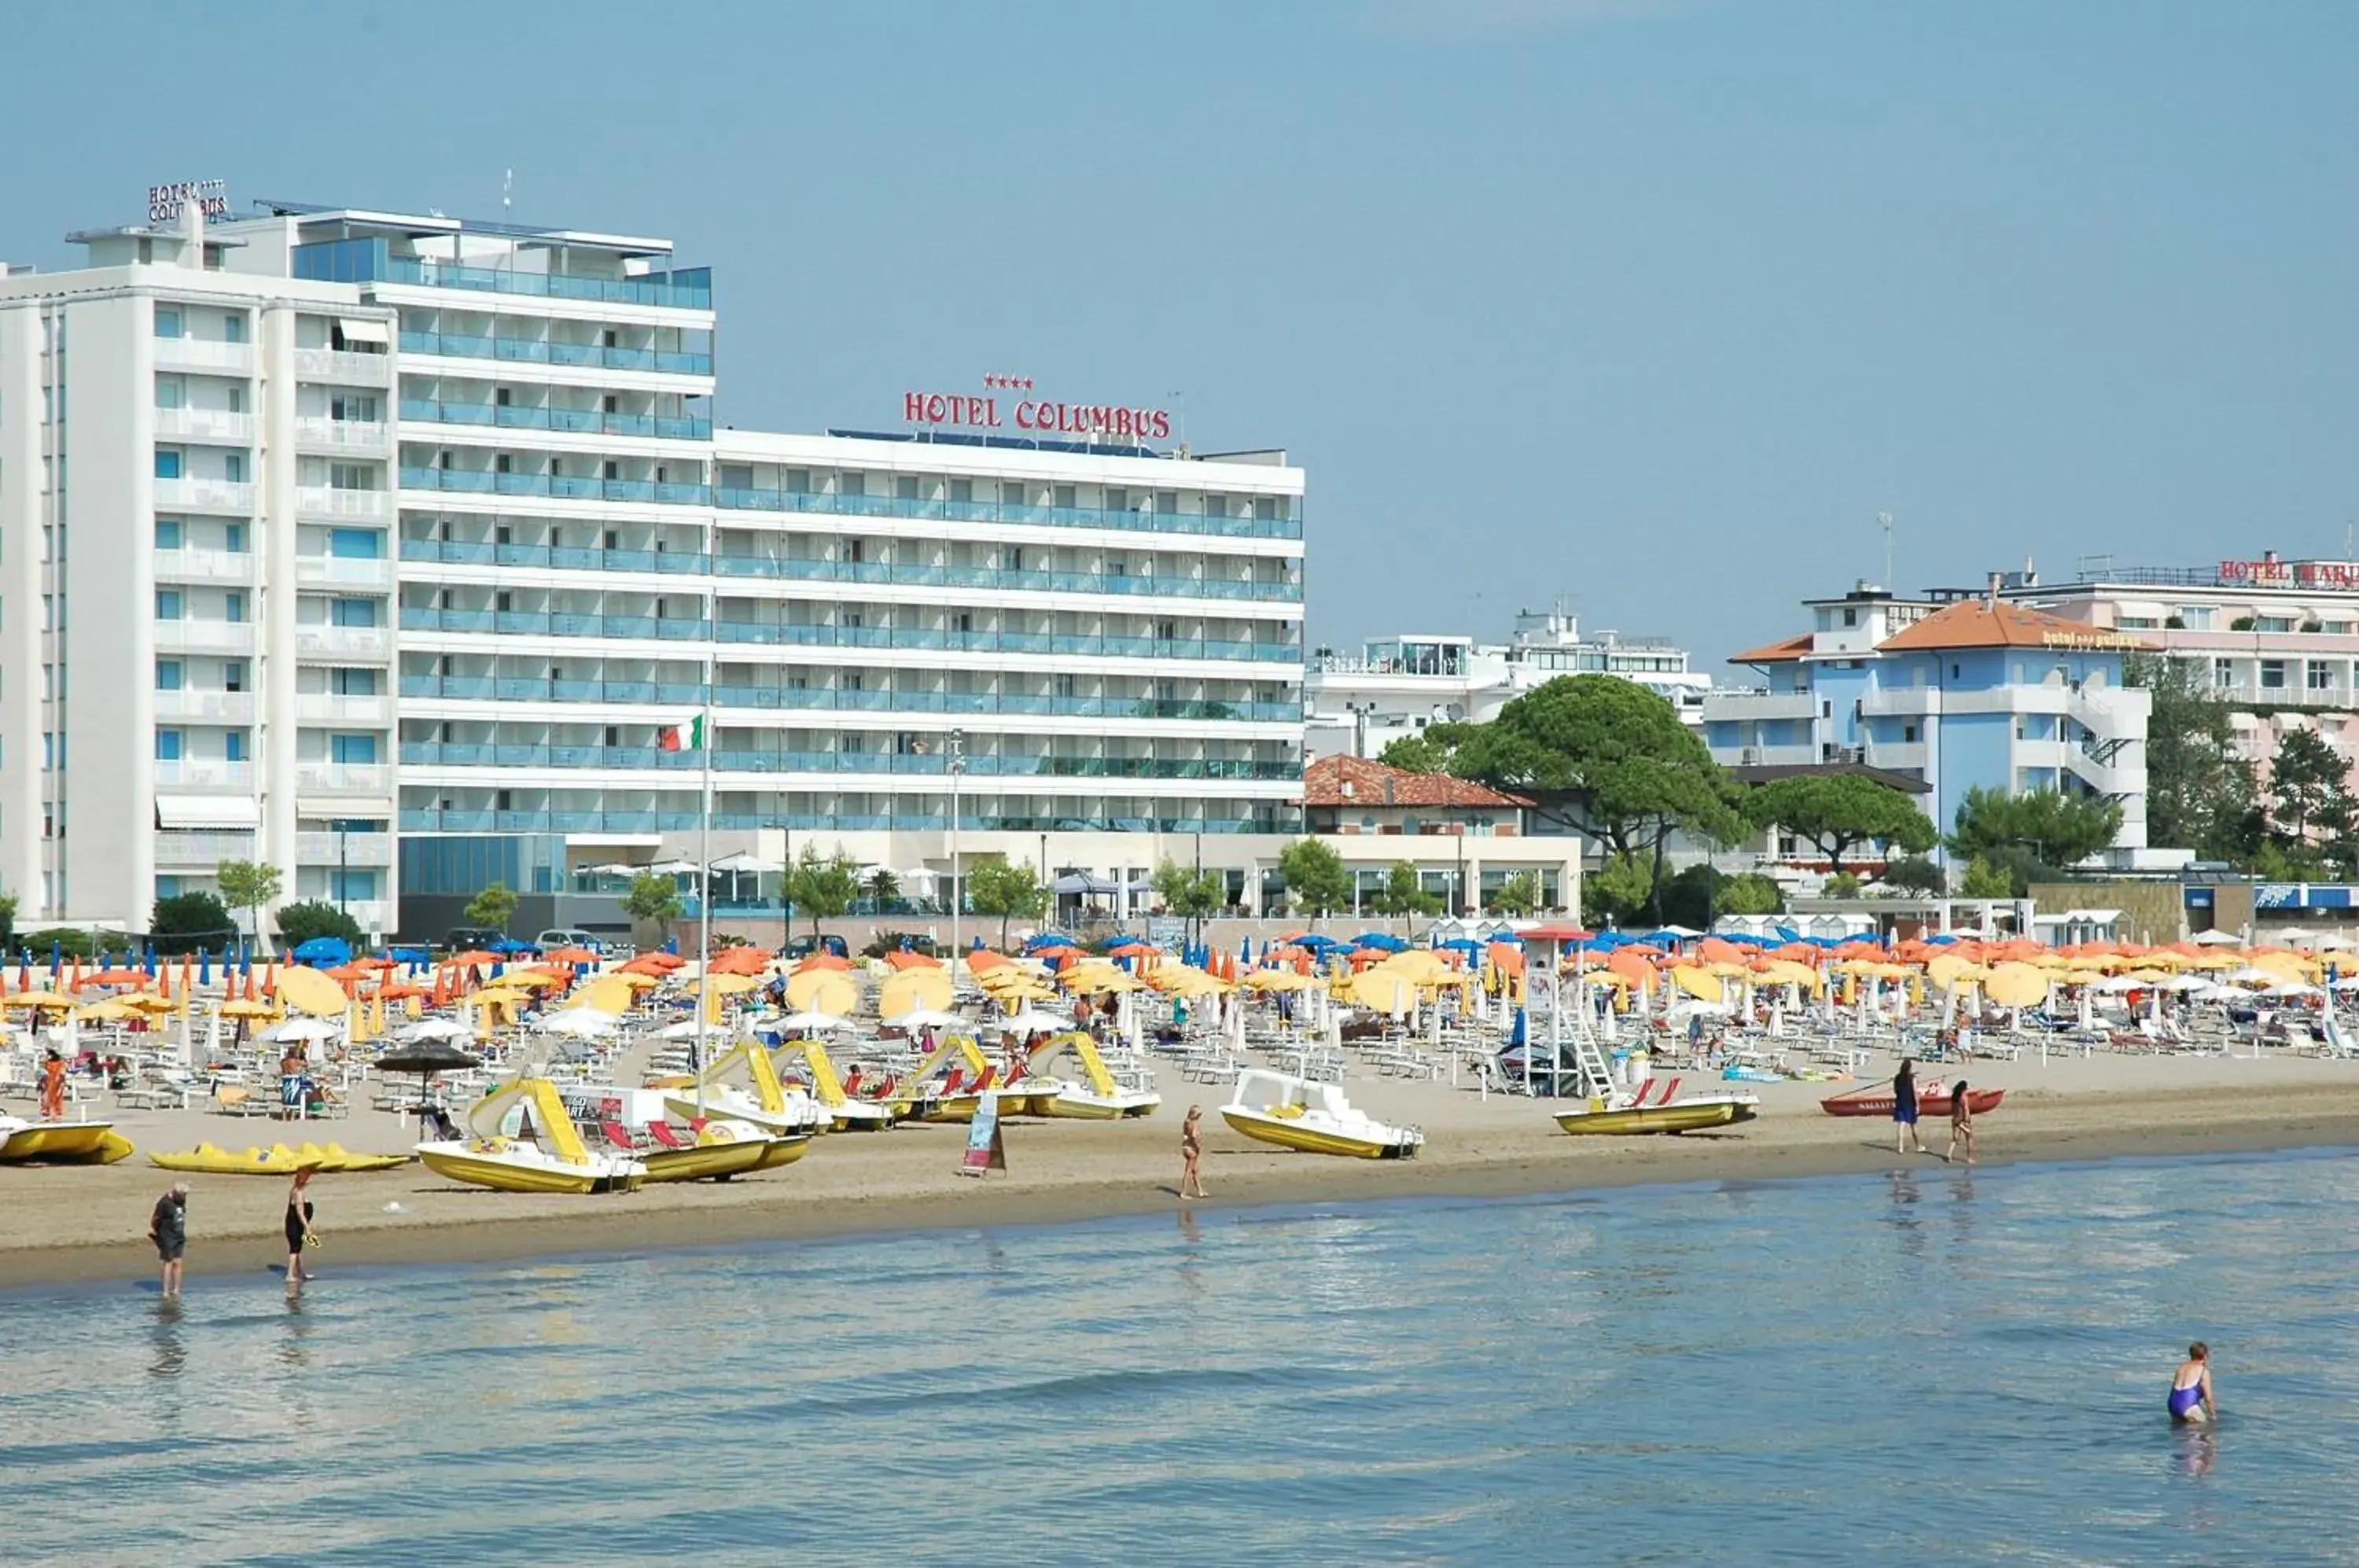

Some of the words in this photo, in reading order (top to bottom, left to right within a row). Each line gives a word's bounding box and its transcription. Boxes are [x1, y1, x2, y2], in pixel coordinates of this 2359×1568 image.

[149, 182, 199, 204] HOTEL
[905, 392, 1001, 427] HOTEL
[1014, 401, 1170, 438] COLUMBUS
[2220, 561, 2290, 580] HOTEL
[2043, 630, 2074, 644] hotel
